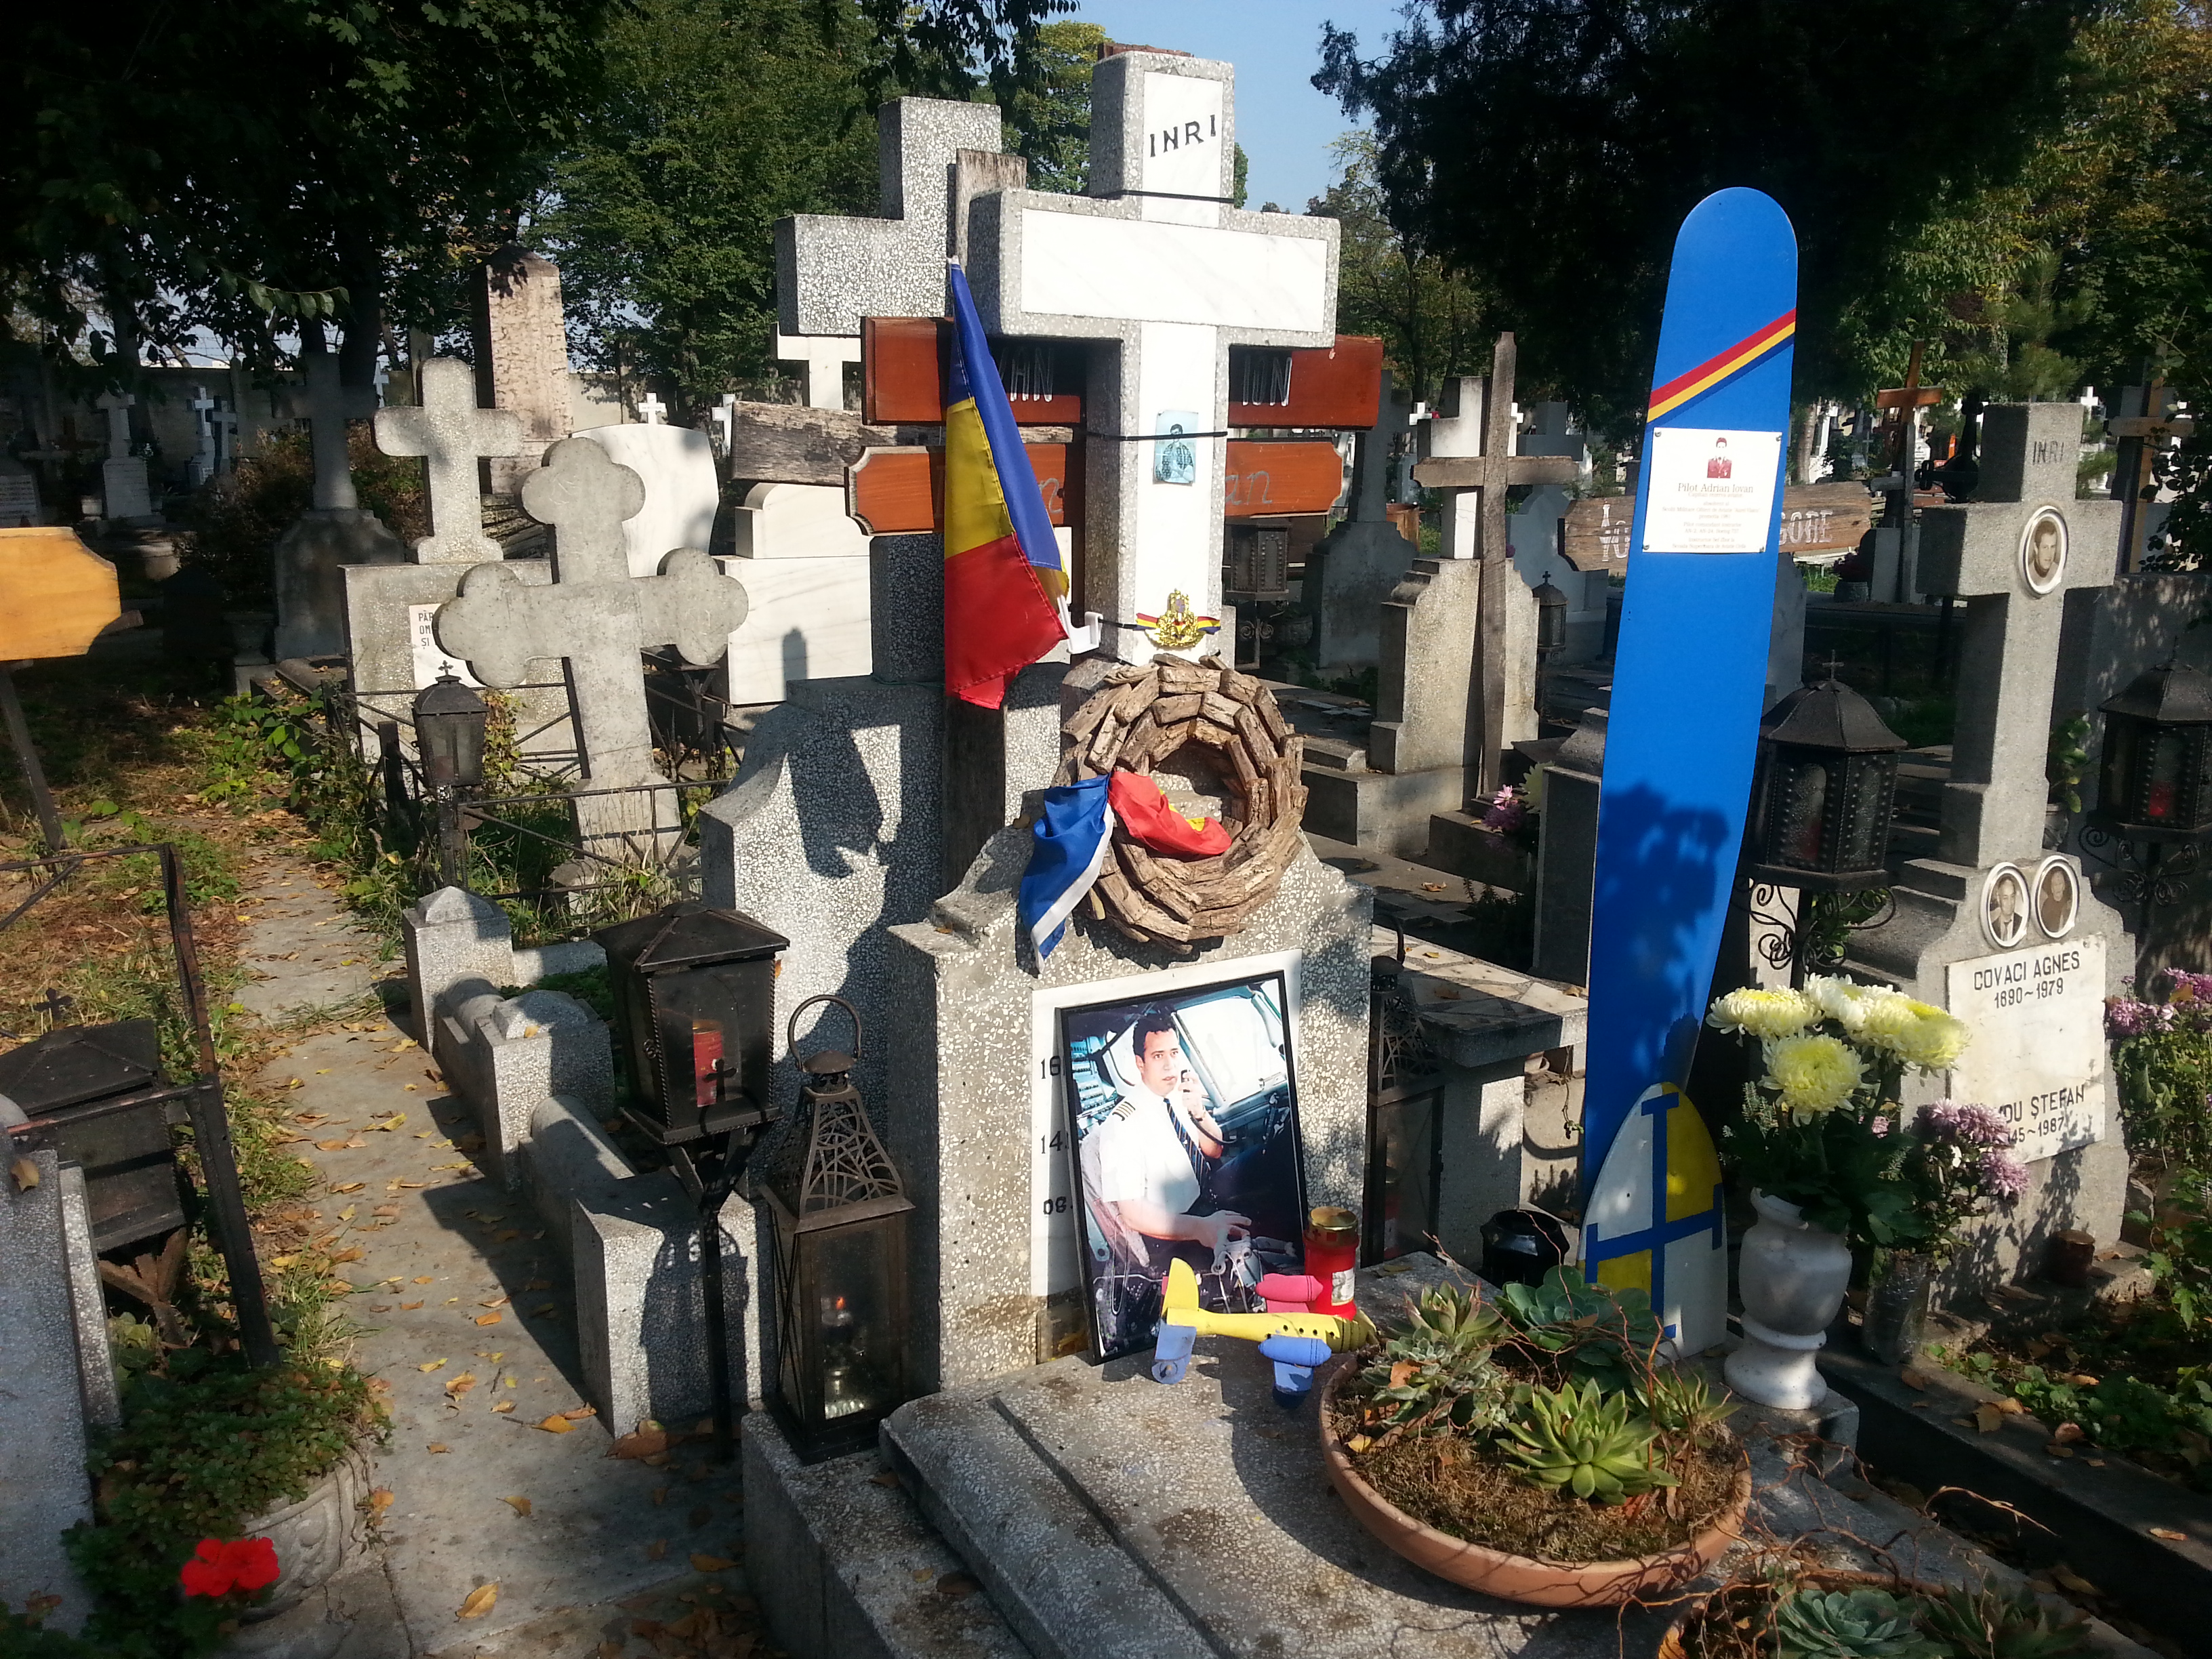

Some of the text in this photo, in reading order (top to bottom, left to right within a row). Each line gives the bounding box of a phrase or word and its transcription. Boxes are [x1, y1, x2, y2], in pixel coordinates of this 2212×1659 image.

[1149, 114, 1216, 157] INRI
[2032, 440, 2064, 466] INRI
[1678, 483, 1753, 493] Pilot Adrian Iovan
[1973, 950, 2081, 991] COVACI AGNES
